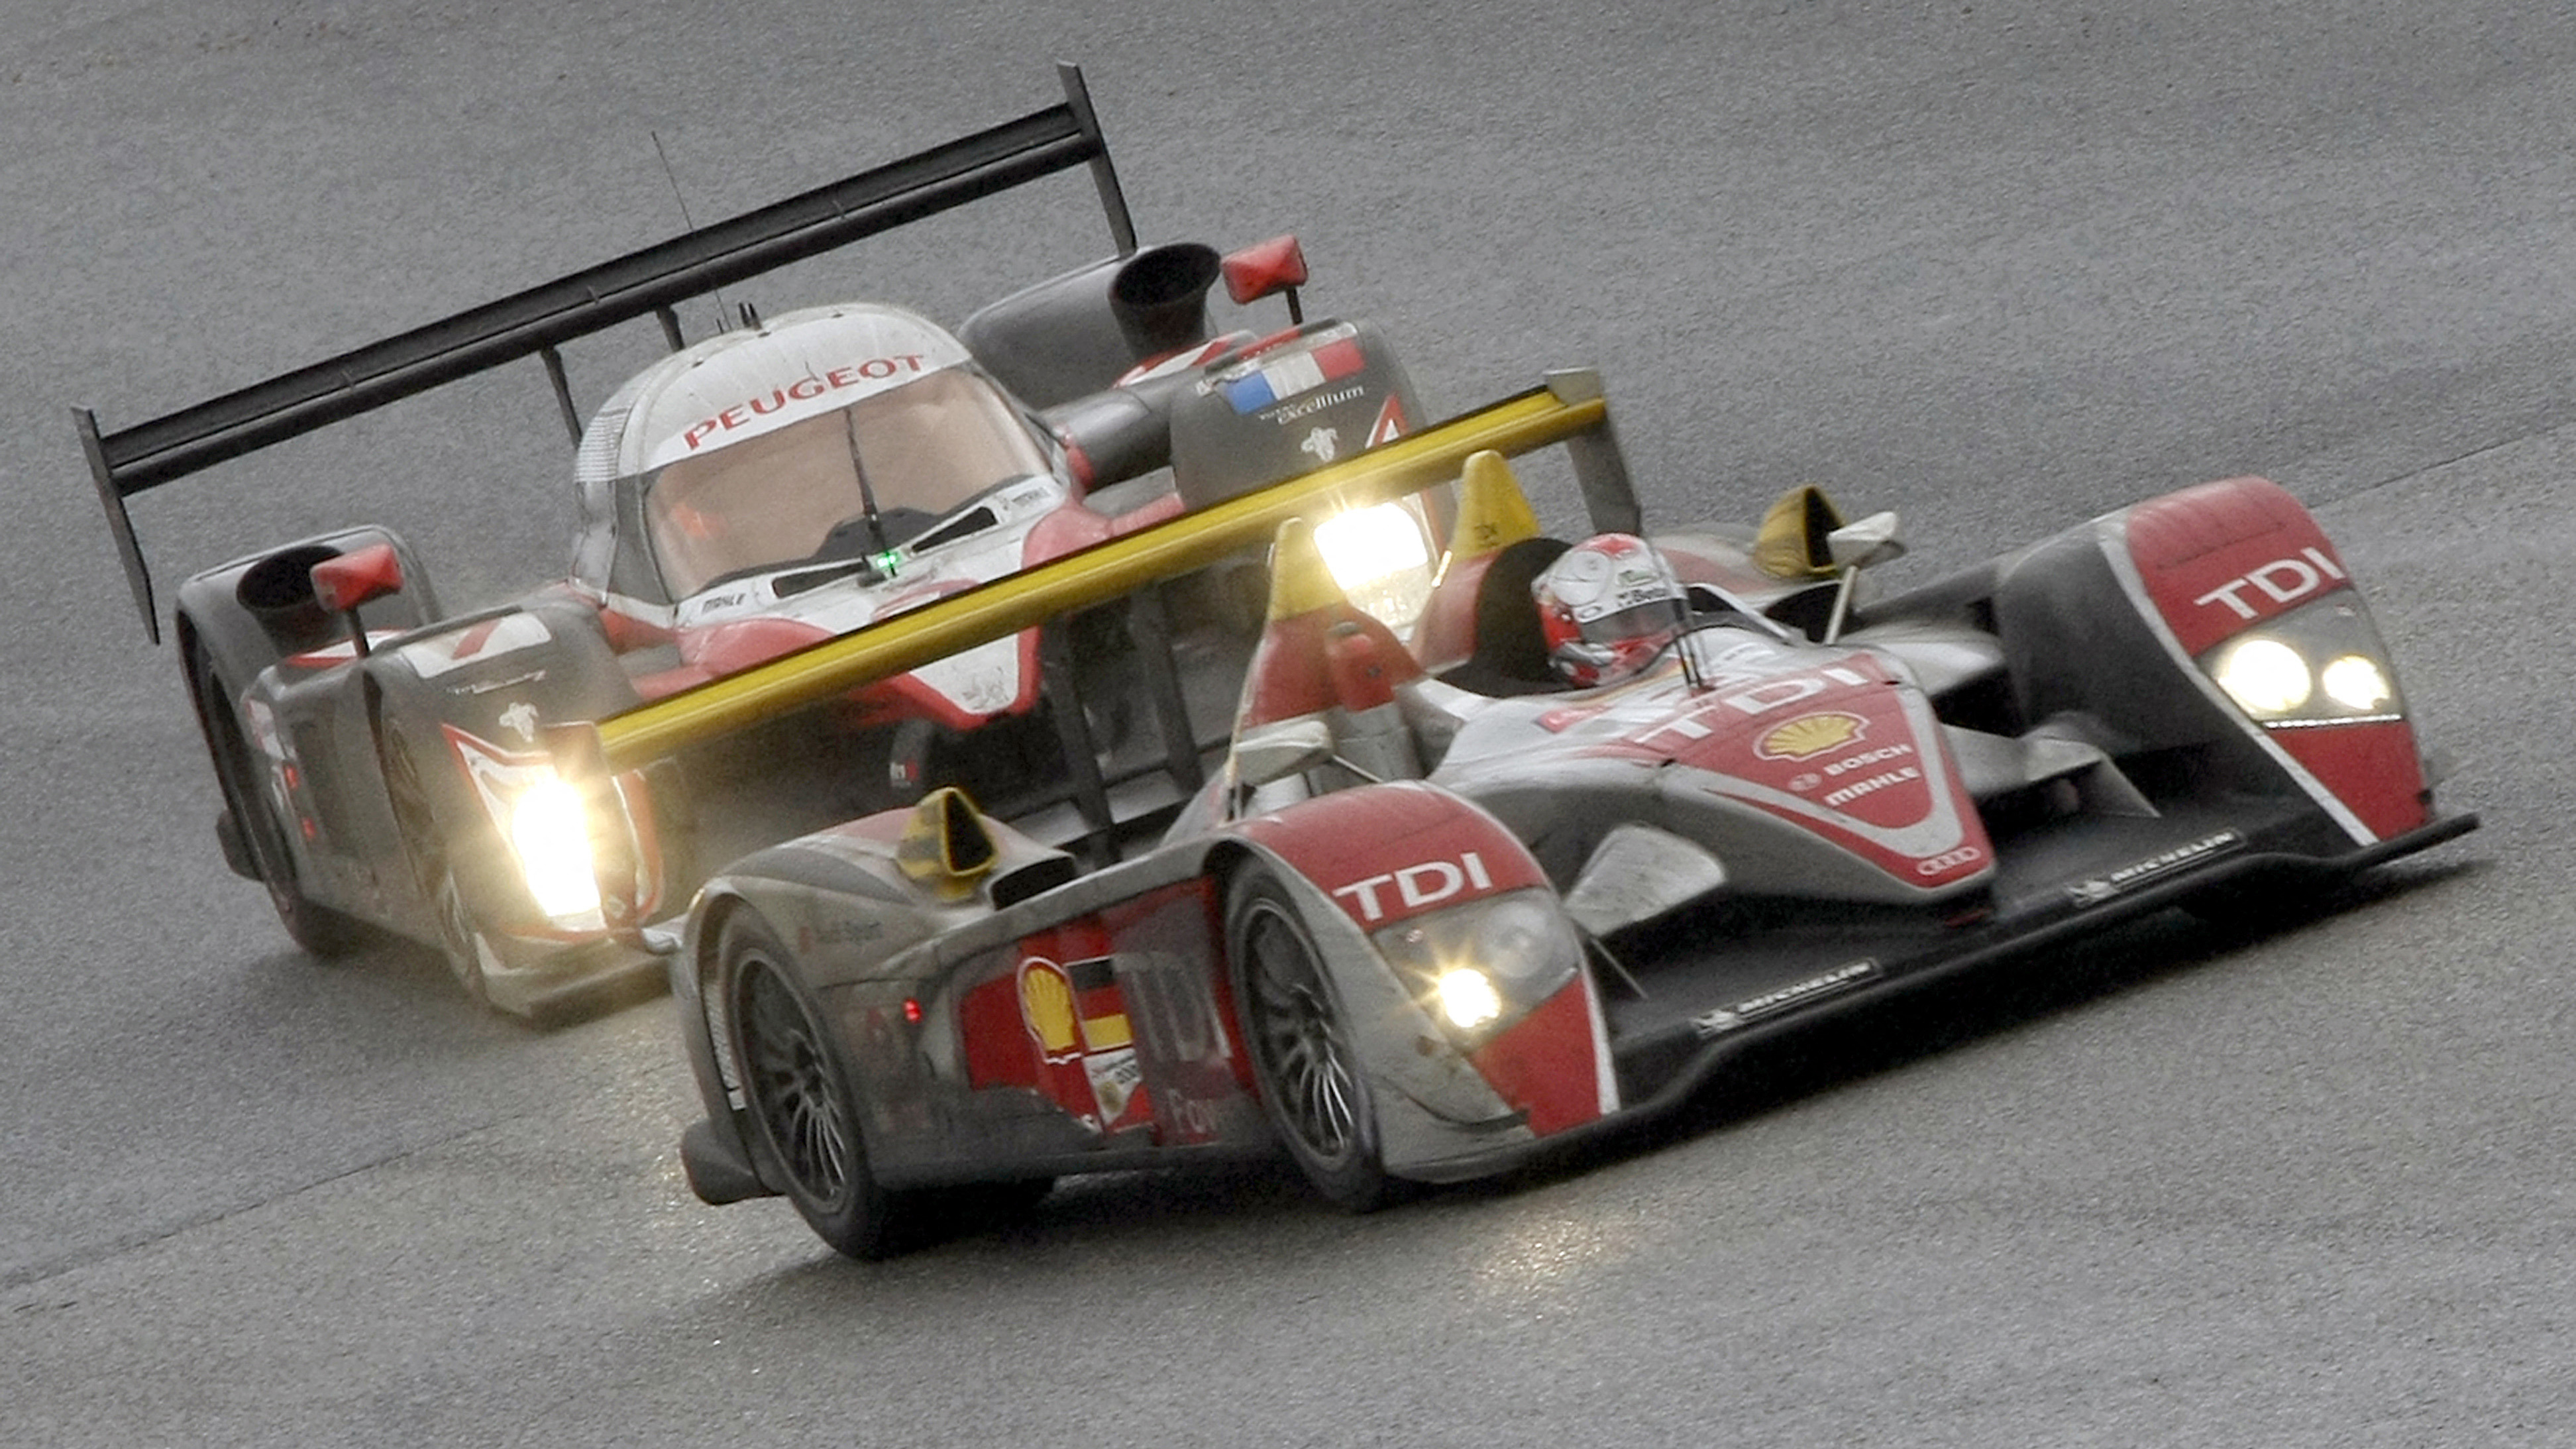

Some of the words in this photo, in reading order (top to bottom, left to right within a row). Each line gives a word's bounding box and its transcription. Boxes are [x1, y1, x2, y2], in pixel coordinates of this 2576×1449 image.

[684, 354, 924, 451] PEUGEOT
[2193, 547, 2346, 619] TDI
[1634, 668, 1868, 743] TDI
[1823, 744, 1913, 776] BOSCH
[1824, 767, 1920, 806] MAHLE
[1332, 851, 1492, 920] TDI
[2110, 832, 2234, 882] MICHELIN
[1737, 961, 1871, 1013] MICHELIN
